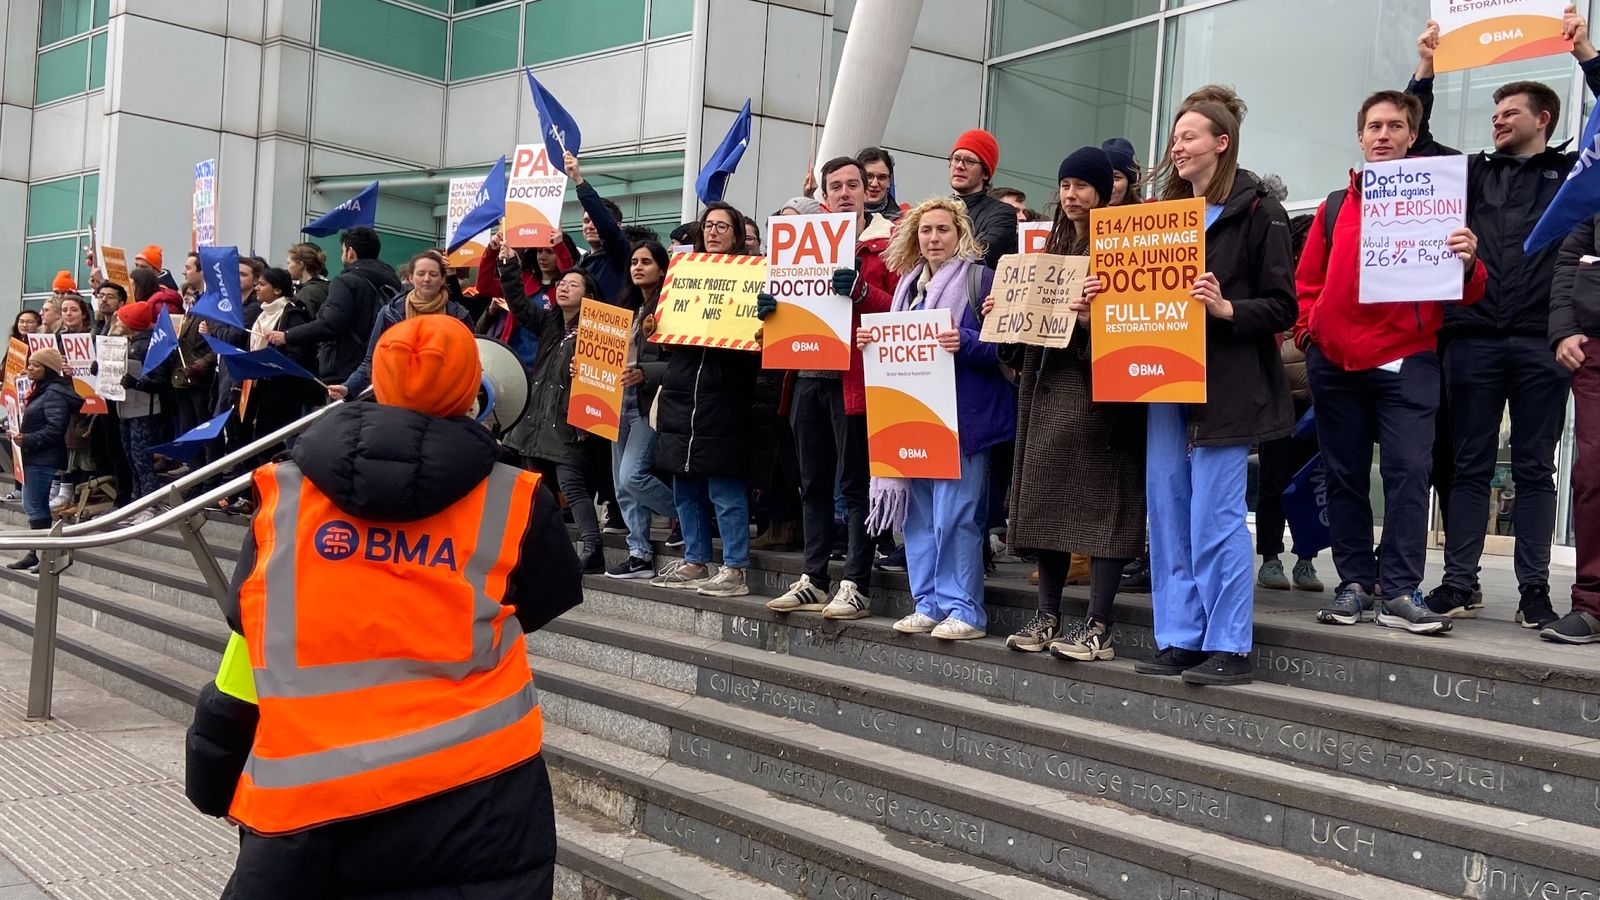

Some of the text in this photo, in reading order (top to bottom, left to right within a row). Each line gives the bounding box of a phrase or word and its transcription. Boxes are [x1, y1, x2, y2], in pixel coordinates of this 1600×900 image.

[1494, 28, 1523, 41] BMA
[513, 148, 558, 177] PA
[512, 178, 551, 186] RESTORATION
[1364, 166, 1431, 188] Doctors
[509, 185, 562, 198] DOCTORS
[1365, 185, 1435, 200] united against
[334, 199, 361, 212] MA
[1363, 199, 1462, 218] PAY EROSION!
[1096, 210, 1198, 235] £14/HOUR IS
[771, 220, 851, 266] PAY
[1095, 230, 1198, 251] NOT A FAIR WAGE
[1363, 236, 1389, 248] Would
[1395, 240, 1416, 254] you
[1095, 246, 1198, 268] FOR A JUNIOR
[1365, 249, 1408, 267] 26%
[1418, 248, 1440, 265] Pay
[770, 266, 829, 278] RESTORATION
[1002, 265, 1076, 286] SALE 26%
[1096, 265, 1198, 294] DOCTOR
[672, 277, 766, 293] RESTORE PROTECT SAVE
[1006, 287, 1028, 303] OFF
[1036, 286, 1070, 296] JUNIOR
[673, 299, 690, 313] PAY
[708, 293, 724, 305] THE
[1041, 297, 1070, 305] DOCTORS
[583, 307, 629, 328] £14/HOUR IS
[702, 308, 722, 320] NHS
[1105, 301, 1189, 322] FULL PAY
[581, 319, 592, 328] NOT
[598, 322, 610, 334] FAIR
[610, 327, 627, 339] WAGE
[996, 312, 1068, 335] ENDS NOW
[1105, 321, 1189, 333] RESTORATION NOW
[64, 337, 91, 360] PAY
[149, 327, 167, 349] MA
[580, 328, 626, 350] FOR A JUNIOR
[801, 341, 820, 352] BMA
[578, 340, 624, 368] DOCTOR
[879, 344, 937, 363] PICKET
[580, 362, 617, 386] FULL PAY
[1140, 363, 1165, 376] BMA
[908, 449, 928, 459] BMA
[364, 526, 457, 572] BMA
[731, 615, 760, 638] UCH
[869, 644, 925, 673] College
[930, 655, 998, 686] Hospital
[1256, 648, 1354, 683] Hospital
[710, 673, 820, 716] College Hospital
[1053, 681, 1097, 706] UCH
[1432, 674, 1496, 705] UCH
[860, 708, 898, 735] UCH
[679, 735, 710, 761] UCH
[1152, 698, 1505, 791] University College Hospital
[942, 726, 1230, 821] University College Hospital
[748, 752, 985, 844] University College Hospital
[663, 812, 696, 842] UCH
[1311, 817, 1376, 857] UCH
[1039, 841, 1090, 877] UCH
